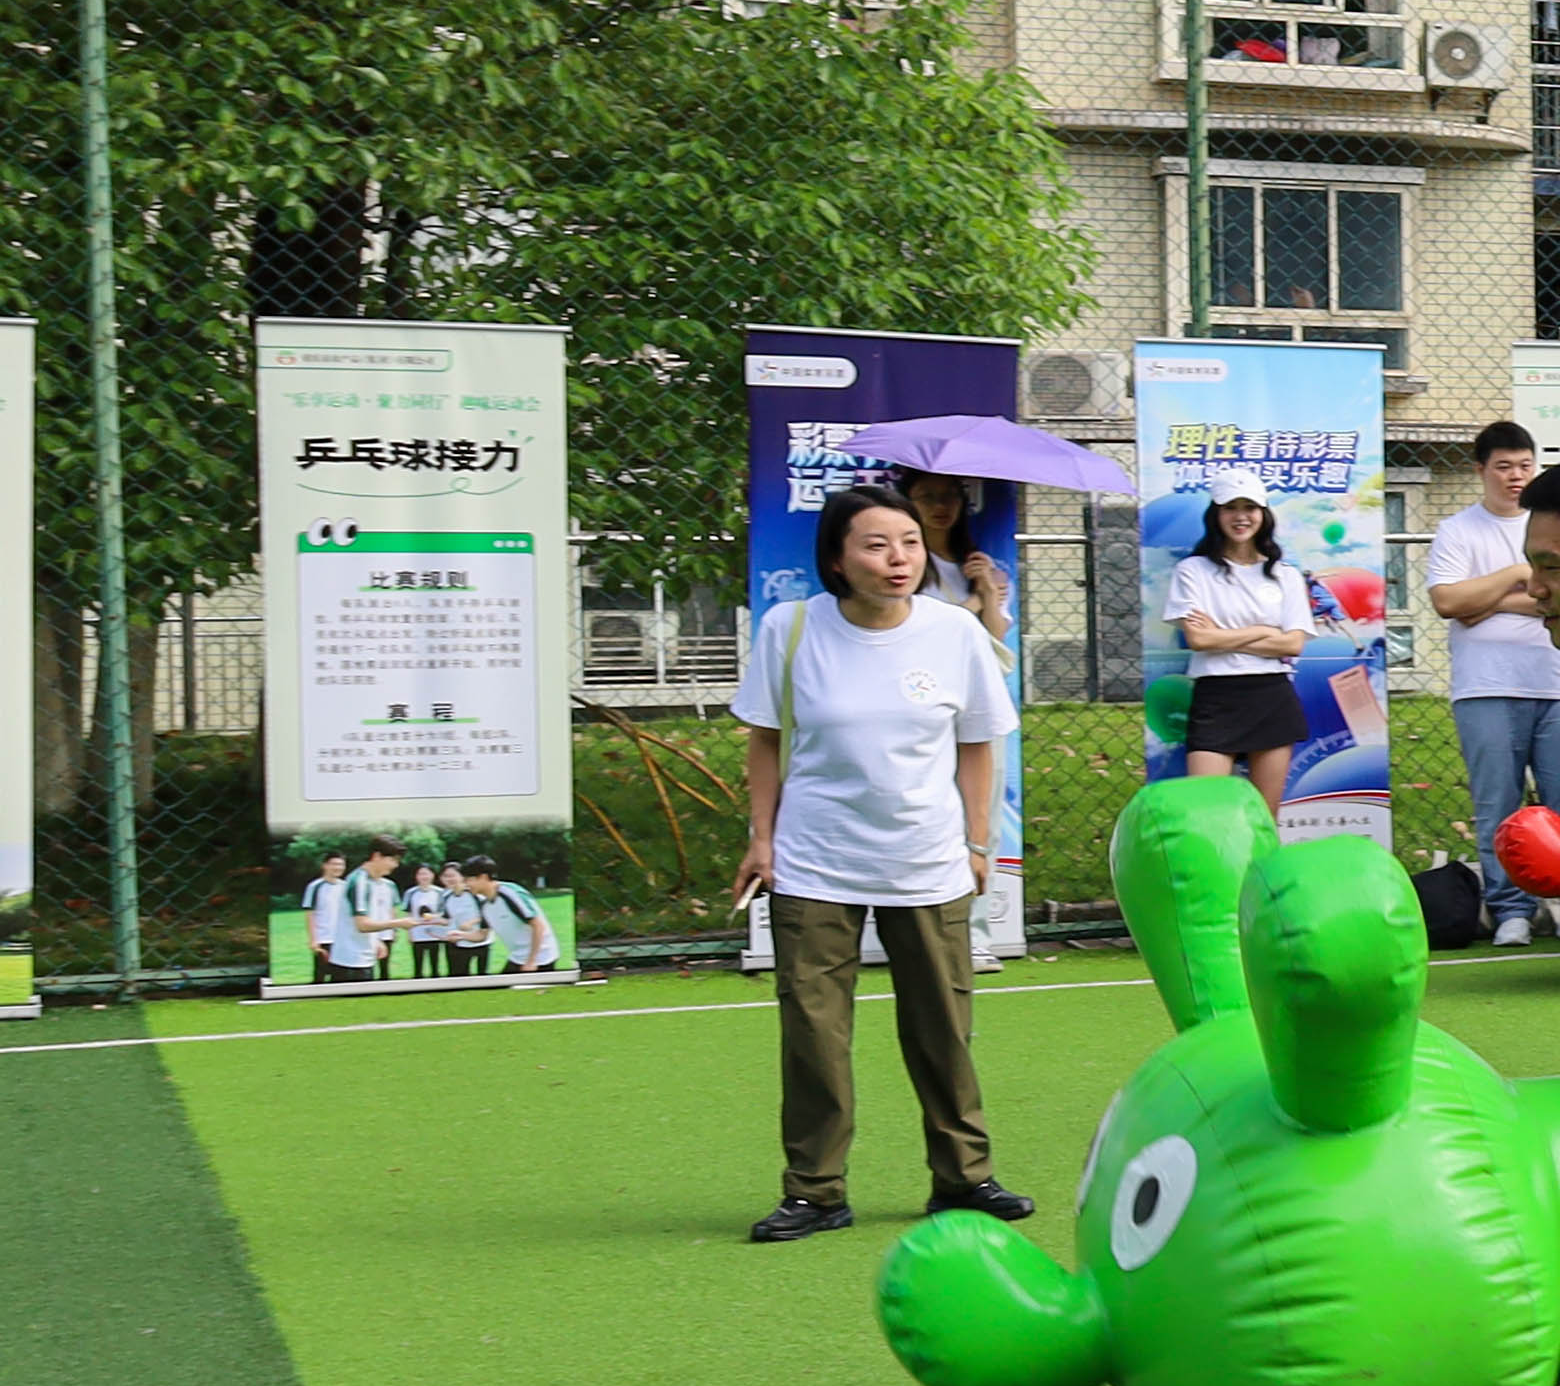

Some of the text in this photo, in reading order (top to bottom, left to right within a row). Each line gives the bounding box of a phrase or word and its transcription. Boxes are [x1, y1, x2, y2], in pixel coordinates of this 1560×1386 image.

[294, 436, 521, 472] 乒乓球接力
[1163, 424, 1358, 462] 理性看待彩票
[370, 570, 470, 590] 比赛规则
